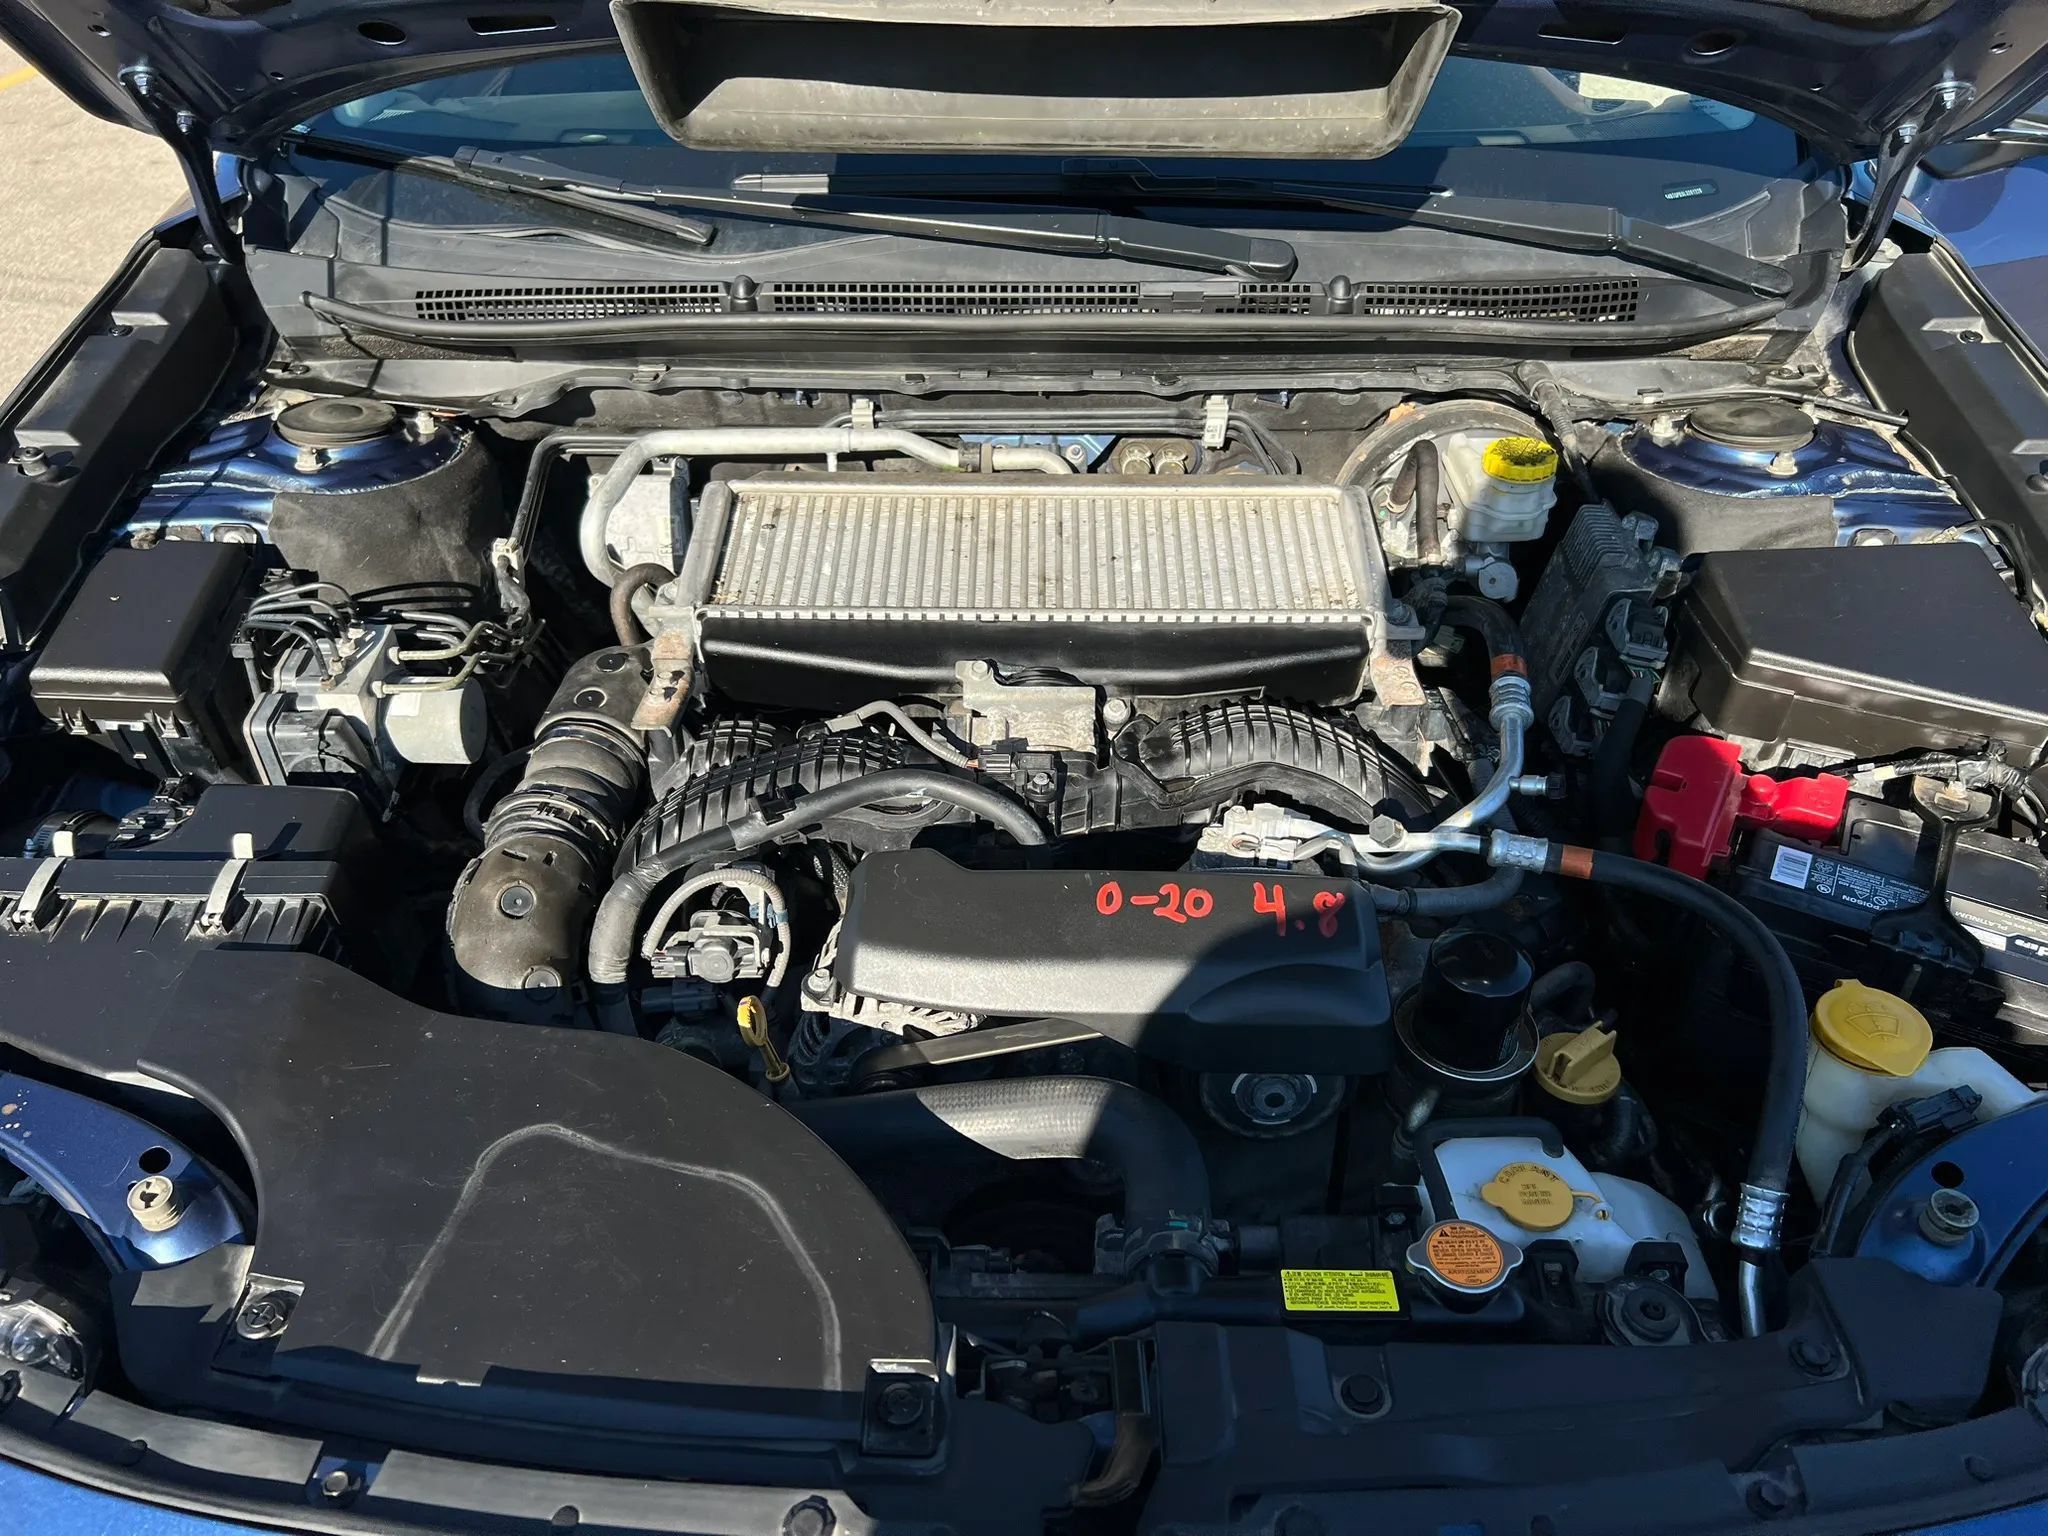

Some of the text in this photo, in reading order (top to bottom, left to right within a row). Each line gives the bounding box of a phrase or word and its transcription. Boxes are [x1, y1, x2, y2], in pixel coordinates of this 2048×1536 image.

[1096, 881, 1346, 938] 0-20 4.8
[1954, 910, 2008, 931] PLATINUM
